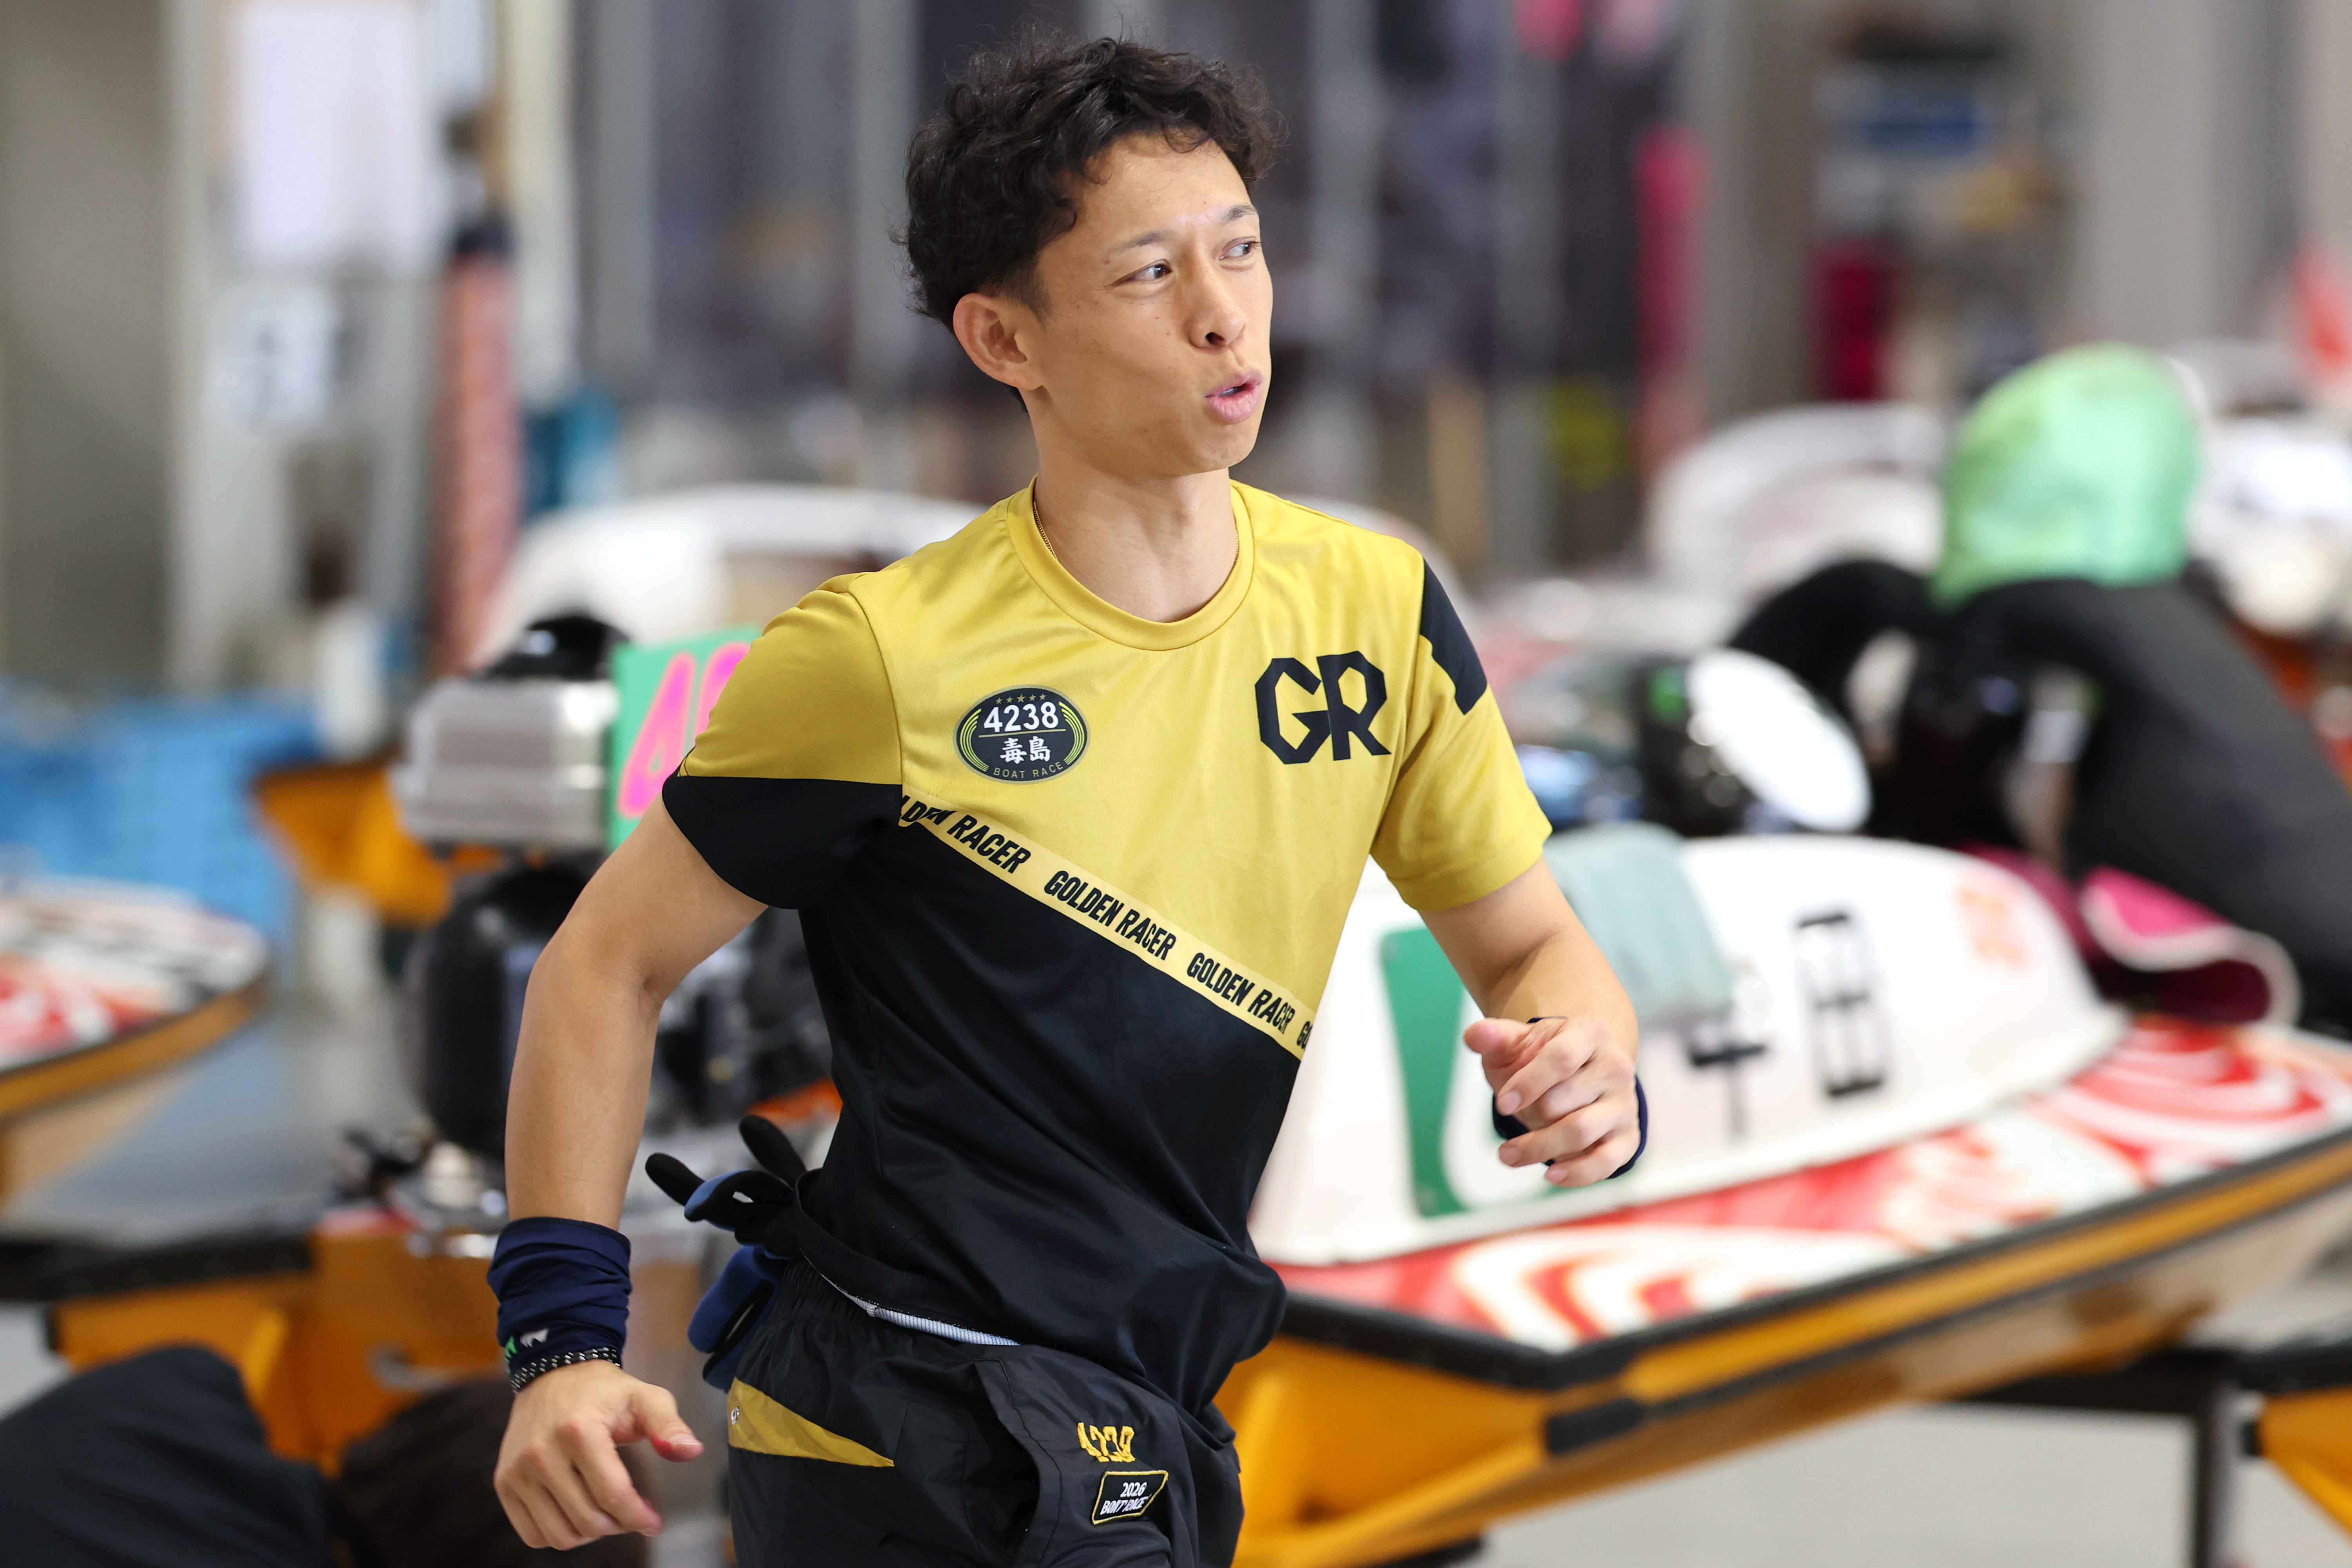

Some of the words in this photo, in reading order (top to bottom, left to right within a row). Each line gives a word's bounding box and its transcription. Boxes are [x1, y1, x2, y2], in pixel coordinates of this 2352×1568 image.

[983, 701, 1059, 732] 4238
[1255, 650, 1392, 764] GR
[1000, 735, 1051, 764] 毒島
[993, 767, 1025, 779] BOAT
[1032, 761, 1064, 778] RACE
[947, 814, 1031, 874] RACER
[1044, 870, 1125, 927] GOLDEN
[1115, 908, 1176, 961] RACER
[1187, 953, 1256, 1006] GOLDEN
[1120, 1482, 1148, 1498] 2026
[1100, 1499, 1129, 1515] BOAT
[1122, 1495, 1149, 1513] RACE
